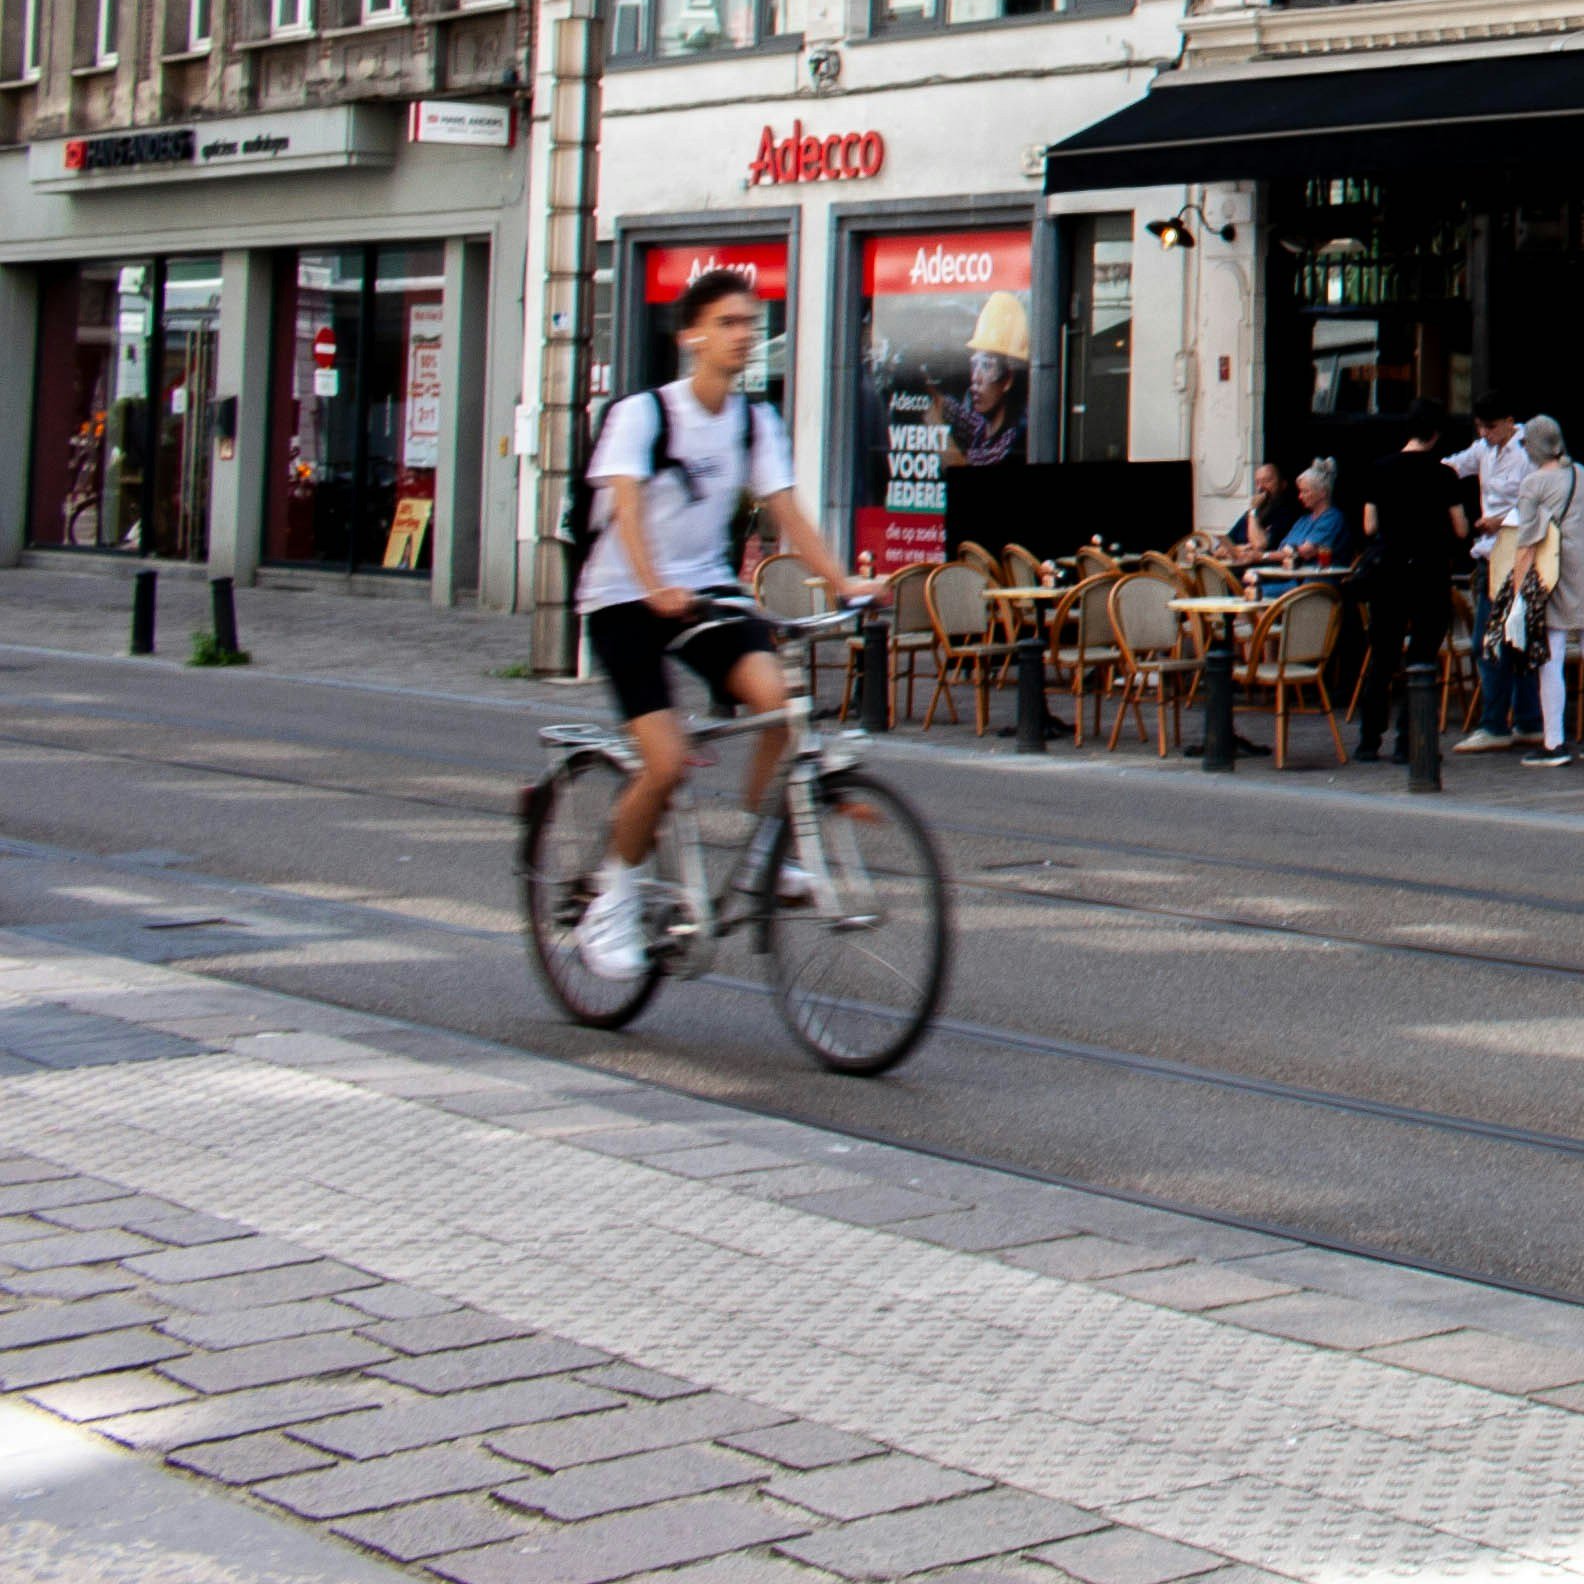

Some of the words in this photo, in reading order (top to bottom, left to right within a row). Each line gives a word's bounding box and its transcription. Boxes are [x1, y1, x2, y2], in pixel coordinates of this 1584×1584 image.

[750, 118, 885, 186] Adecco
[909, 244, 994, 286] Adecco
[890, 391, 929, 410] Adecco
[888, 424, 952, 451] WERKT
[888, 453, 940, 479] VOOR
